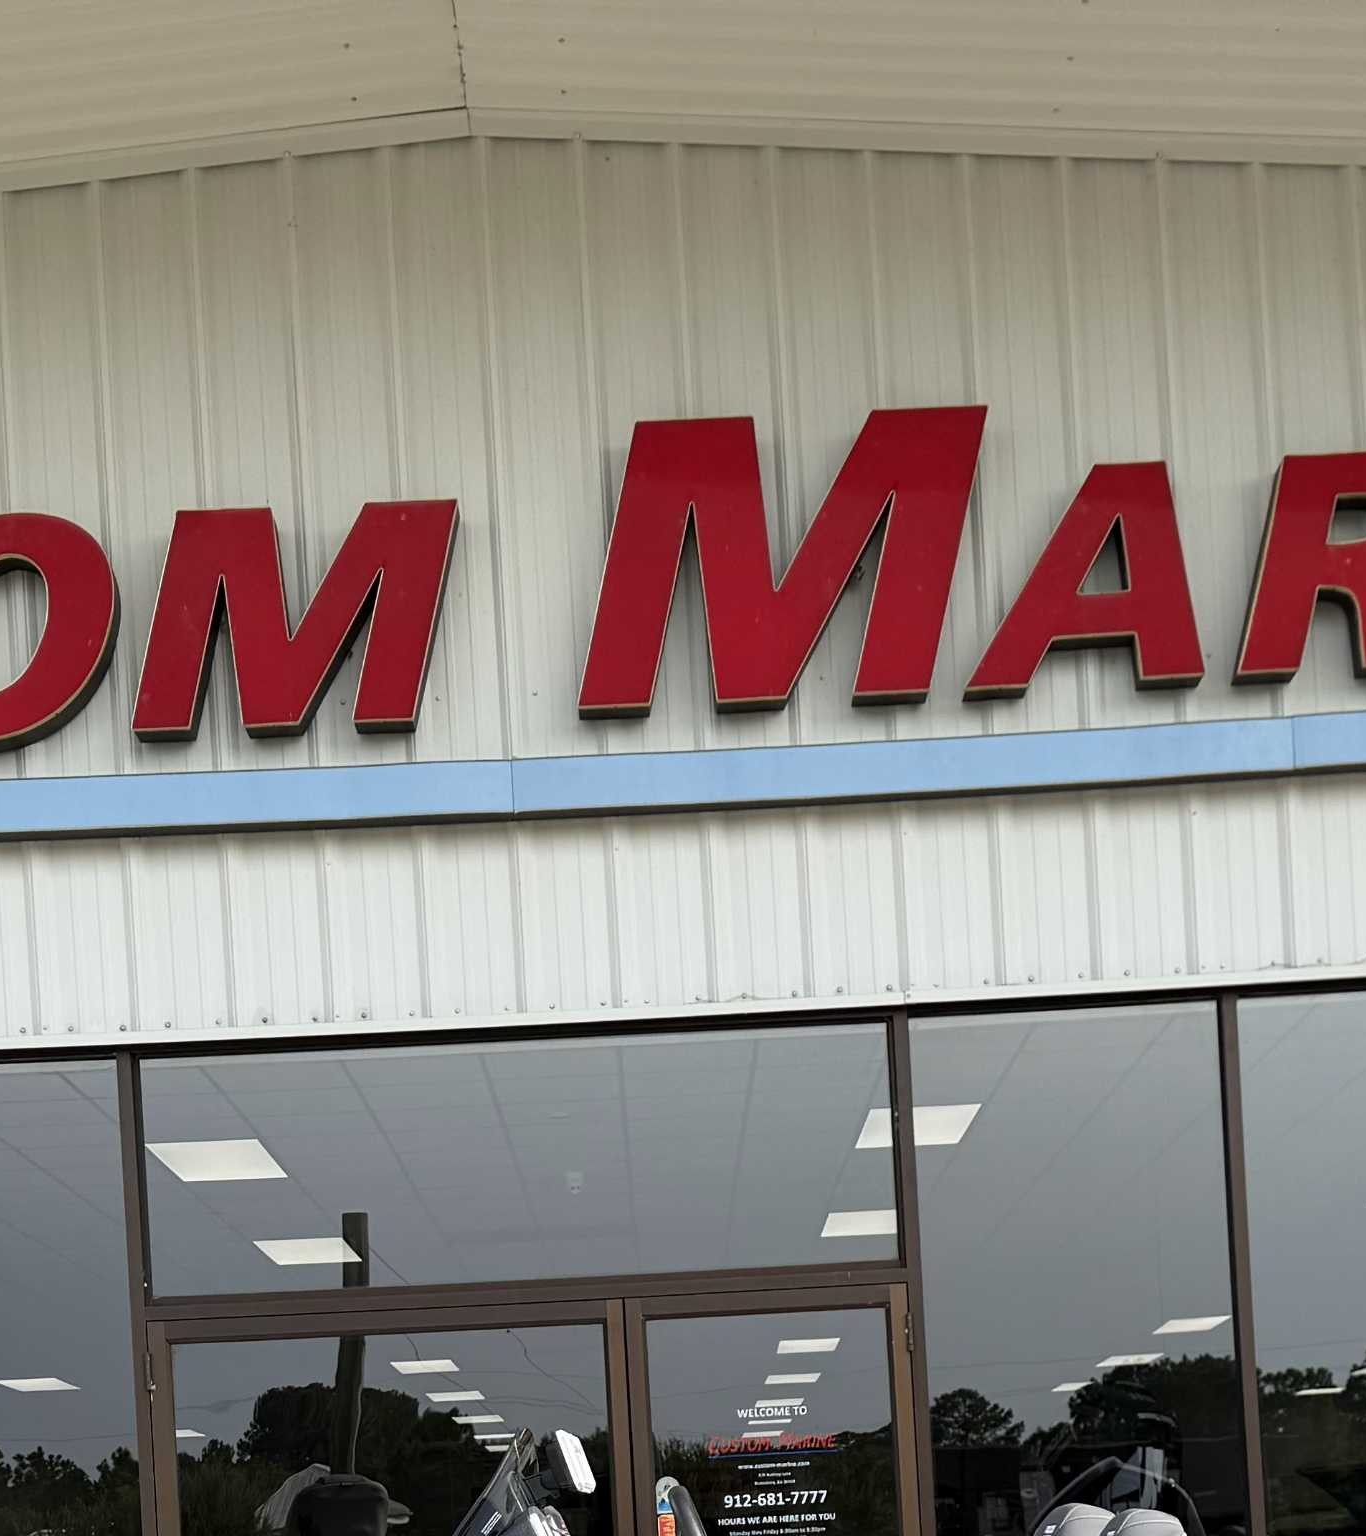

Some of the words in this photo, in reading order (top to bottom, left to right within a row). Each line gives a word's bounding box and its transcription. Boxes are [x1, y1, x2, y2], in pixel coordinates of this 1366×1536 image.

[737, 1406, 791, 1418] WELCOME
[794, 1405, 808, 1416] TO
[724, 1489, 828, 1508] 912-681-7777
[718, 1517, 746, 1526] HOURS
[747, 1516, 761, 1525] WE
[762, 1515, 778, 1524] ARE
[779, 1514, 799, 1523] HERE
[801, 1513, 817, 1522] FOR
[818, 1512, 835, 1521] YOU
